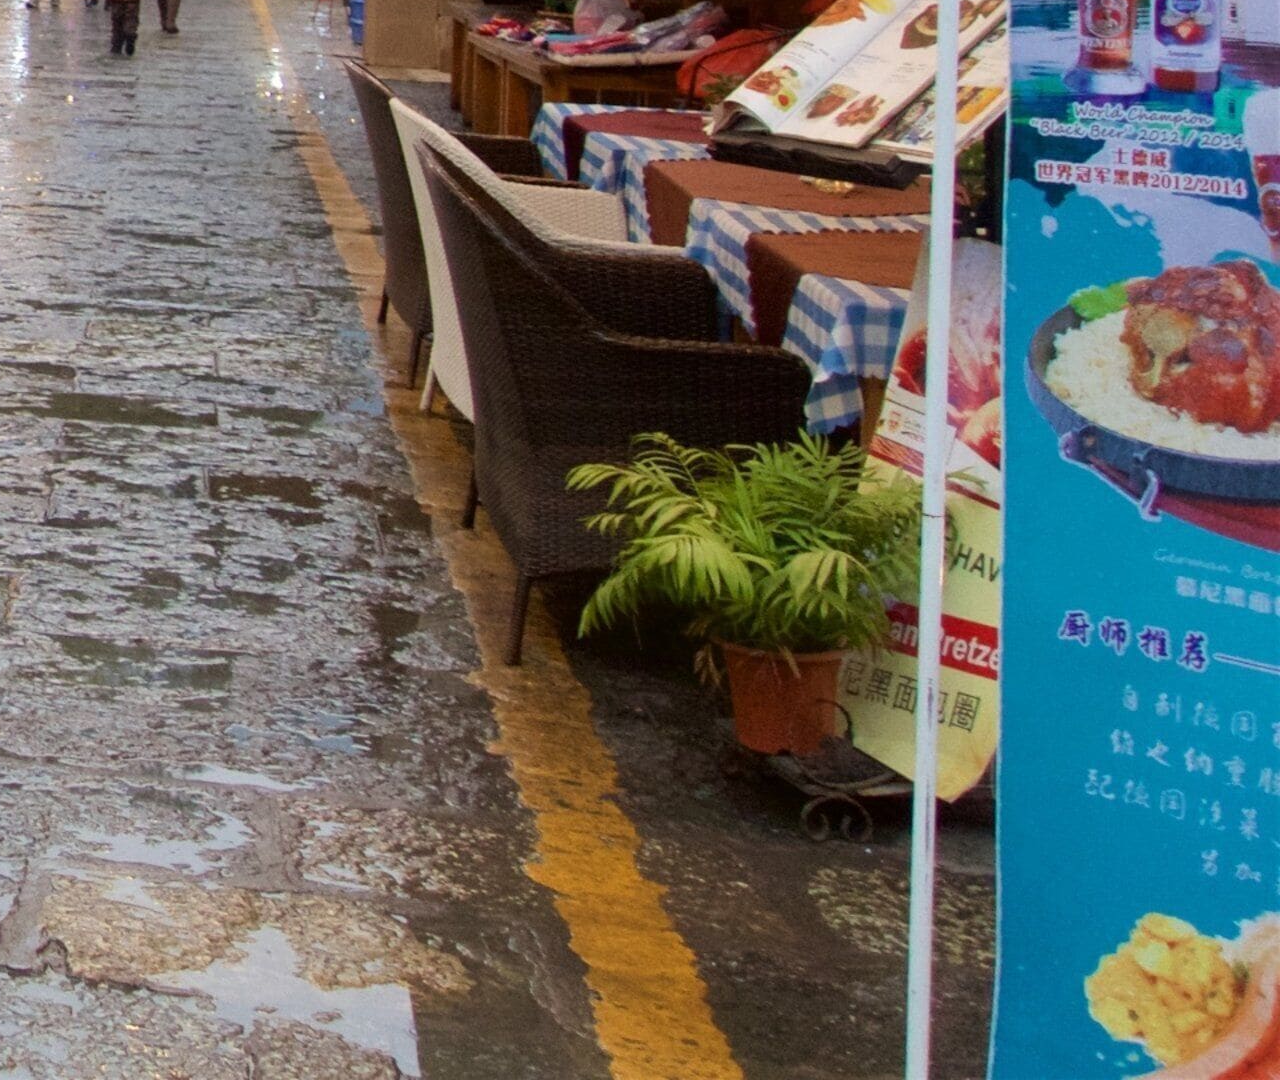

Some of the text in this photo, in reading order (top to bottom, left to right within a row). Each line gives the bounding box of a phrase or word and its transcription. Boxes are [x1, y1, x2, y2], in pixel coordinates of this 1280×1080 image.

[1073, 102, 1214, 127] World Champion
[1140, 127, 1179, 143] 2012
[1200, 133, 1245, 149] 2014
[1060, 611, 1208, 671] 厨师推荐
